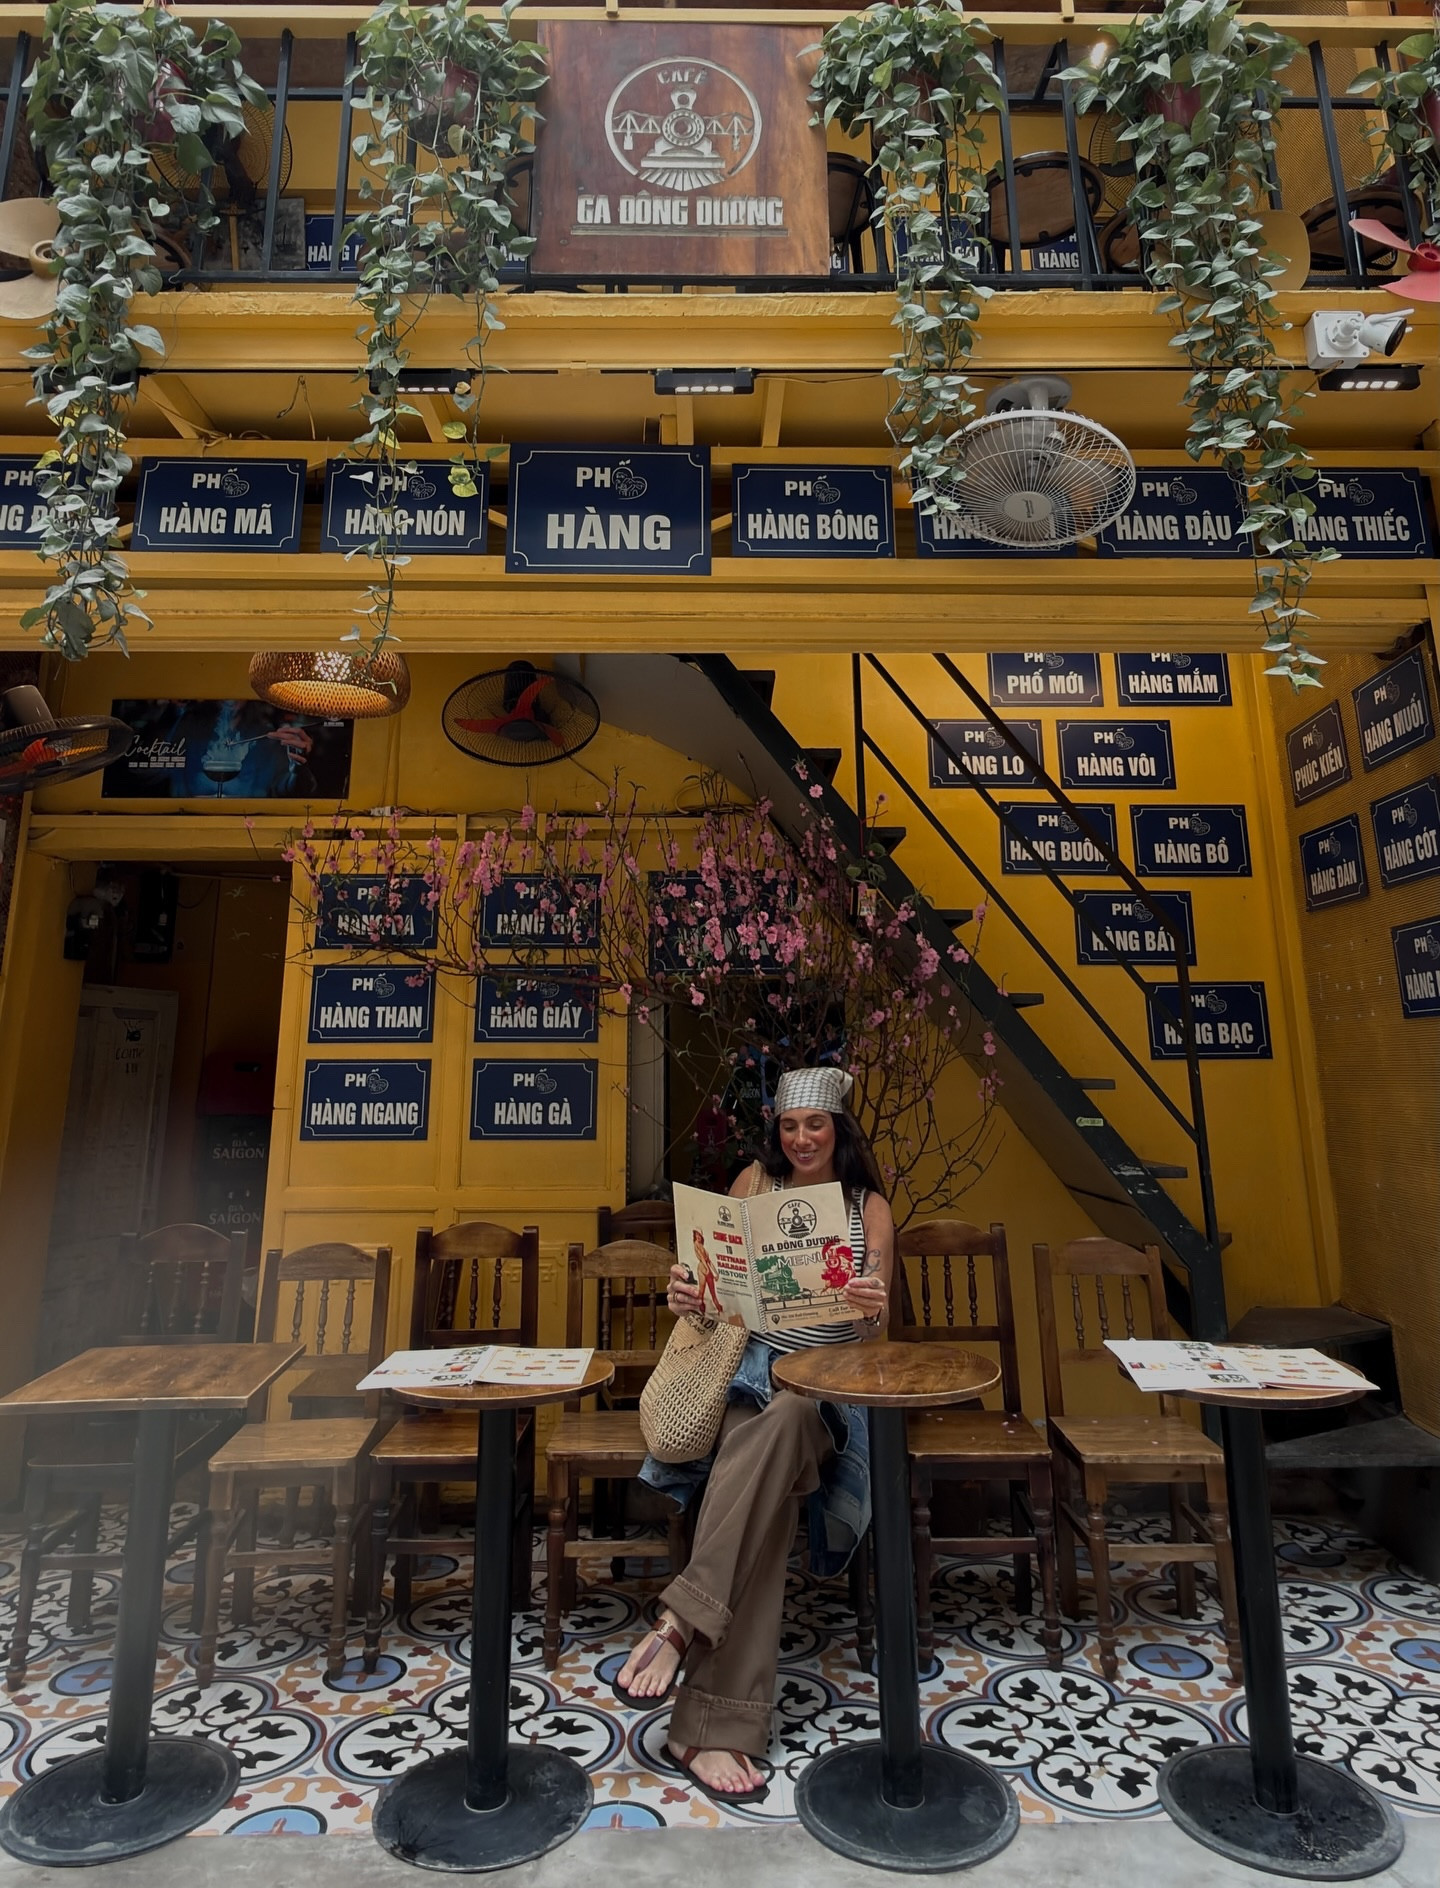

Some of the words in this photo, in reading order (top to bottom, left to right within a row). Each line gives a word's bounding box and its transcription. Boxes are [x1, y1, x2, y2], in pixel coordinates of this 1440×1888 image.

[577, 194, 611, 225] GA
[618, 190, 689, 226] ĐÔNG
[696, 194, 784, 226] DƯƠNG
[307, 241, 350, 263] HÀG
[1038, 249, 1080, 269] HÀNG
[159, 507, 226, 534] HÀNG
[234, 503, 273, 535] MÃ
[344, 503, 410, 535] HÀNG
[415, 504, 465, 536] NÓN
[546, 506, 672, 551] HÀNG
[747, 508, 810, 540] HÀNG
[816, 508, 879, 541] BÔNG
[1116, 510, 1182, 541] HÀNG
[1185, 511, 1233, 546] ĐẬU
[1352, 508, 1410, 541] THIẾC
[1007, 669, 1043, 694] PHỐ
[1049, 672, 1084, 694] MỚI
[1128, 670, 1173, 694] HÀNG
[1175, 667, 1219, 694] MẮM
[1363, 717, 1394, 754] HÀNG
[1392, 692, 1425, 738] MUỐI
[1077, 752, 1124, 777] HÀNG
[1127, 753, 1157, 777] VÔI
[1294, 759, 1319, 791] PHÚC
[1319, 742, 1344, 778] KIẾN
[1153, 839, 1201, 864] HÀNG
[1206, 836, 1230, 864] BỒ
[1383, 838, 1415, 871] HÀNG
[1415, 826, 1439, 861] CÓT
[1310, 867, 1337, 896] HÀNG
[1405, 968, 1436, 1001] HÀNG
[320, 1003, 370, 1029] HÀNG
[375, 1005, 423, 1029] THAN
[490, 1001, 538, 1028] HÀNG
[542, 999, 583, 1028] GIẤY
[1217, 1021, 1254, 1049] BẠC
[310, 1098, 356, 1126] HÀNG
[360, 1101, 419, 1126] NGANG
[494, 1097, 543, 1126] HÀNG
[547, 1097, 572, 1126] GÀ
[212, 1147, 265, 1160] SAIGON
[208, 1212, 262, 1225] SAIGON
[761, 1244, 775, 1253] GA
[718, 1269, 749, 1280] HISTORY
